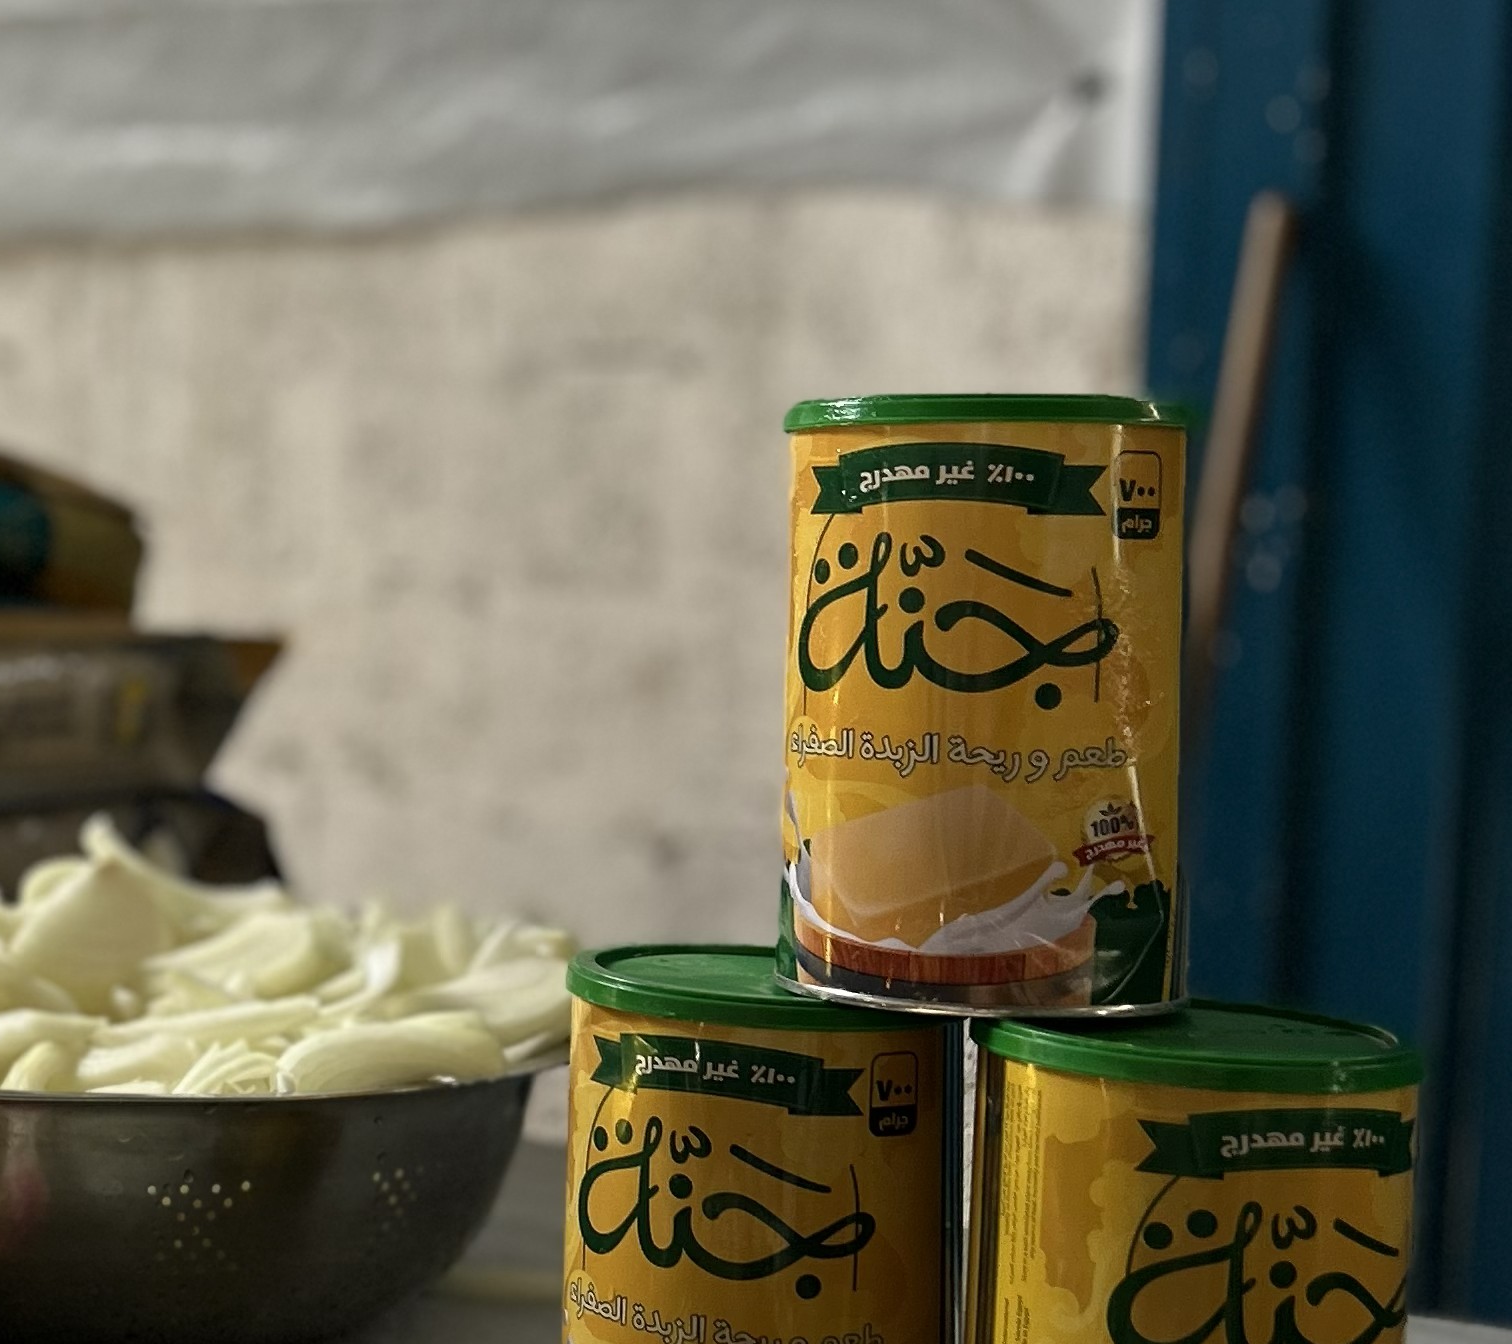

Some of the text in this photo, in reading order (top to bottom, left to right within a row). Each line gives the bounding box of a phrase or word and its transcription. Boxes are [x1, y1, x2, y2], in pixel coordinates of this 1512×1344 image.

[859, 463, 931, 494] مهدرج
[935, 460, 975, 485] غير
[1119, 477, 1156, 501] ٧٠٠
[1121, 516, 1153, 533] جرام
[790, 723, 1128, 782] طعم و ريحة الزبدة الصفراء
[635, 1054, 698, 1076] مهدرج
[702, 1059, 739, 1082] غير
[876, 1079, 913, 1102] ٧٠٠
[1220, 1131, 1305, 1158] مهدرج
[1309, 1126, 1347, 1153] غير
[569, 1278, 628, 1326] الصفراء
